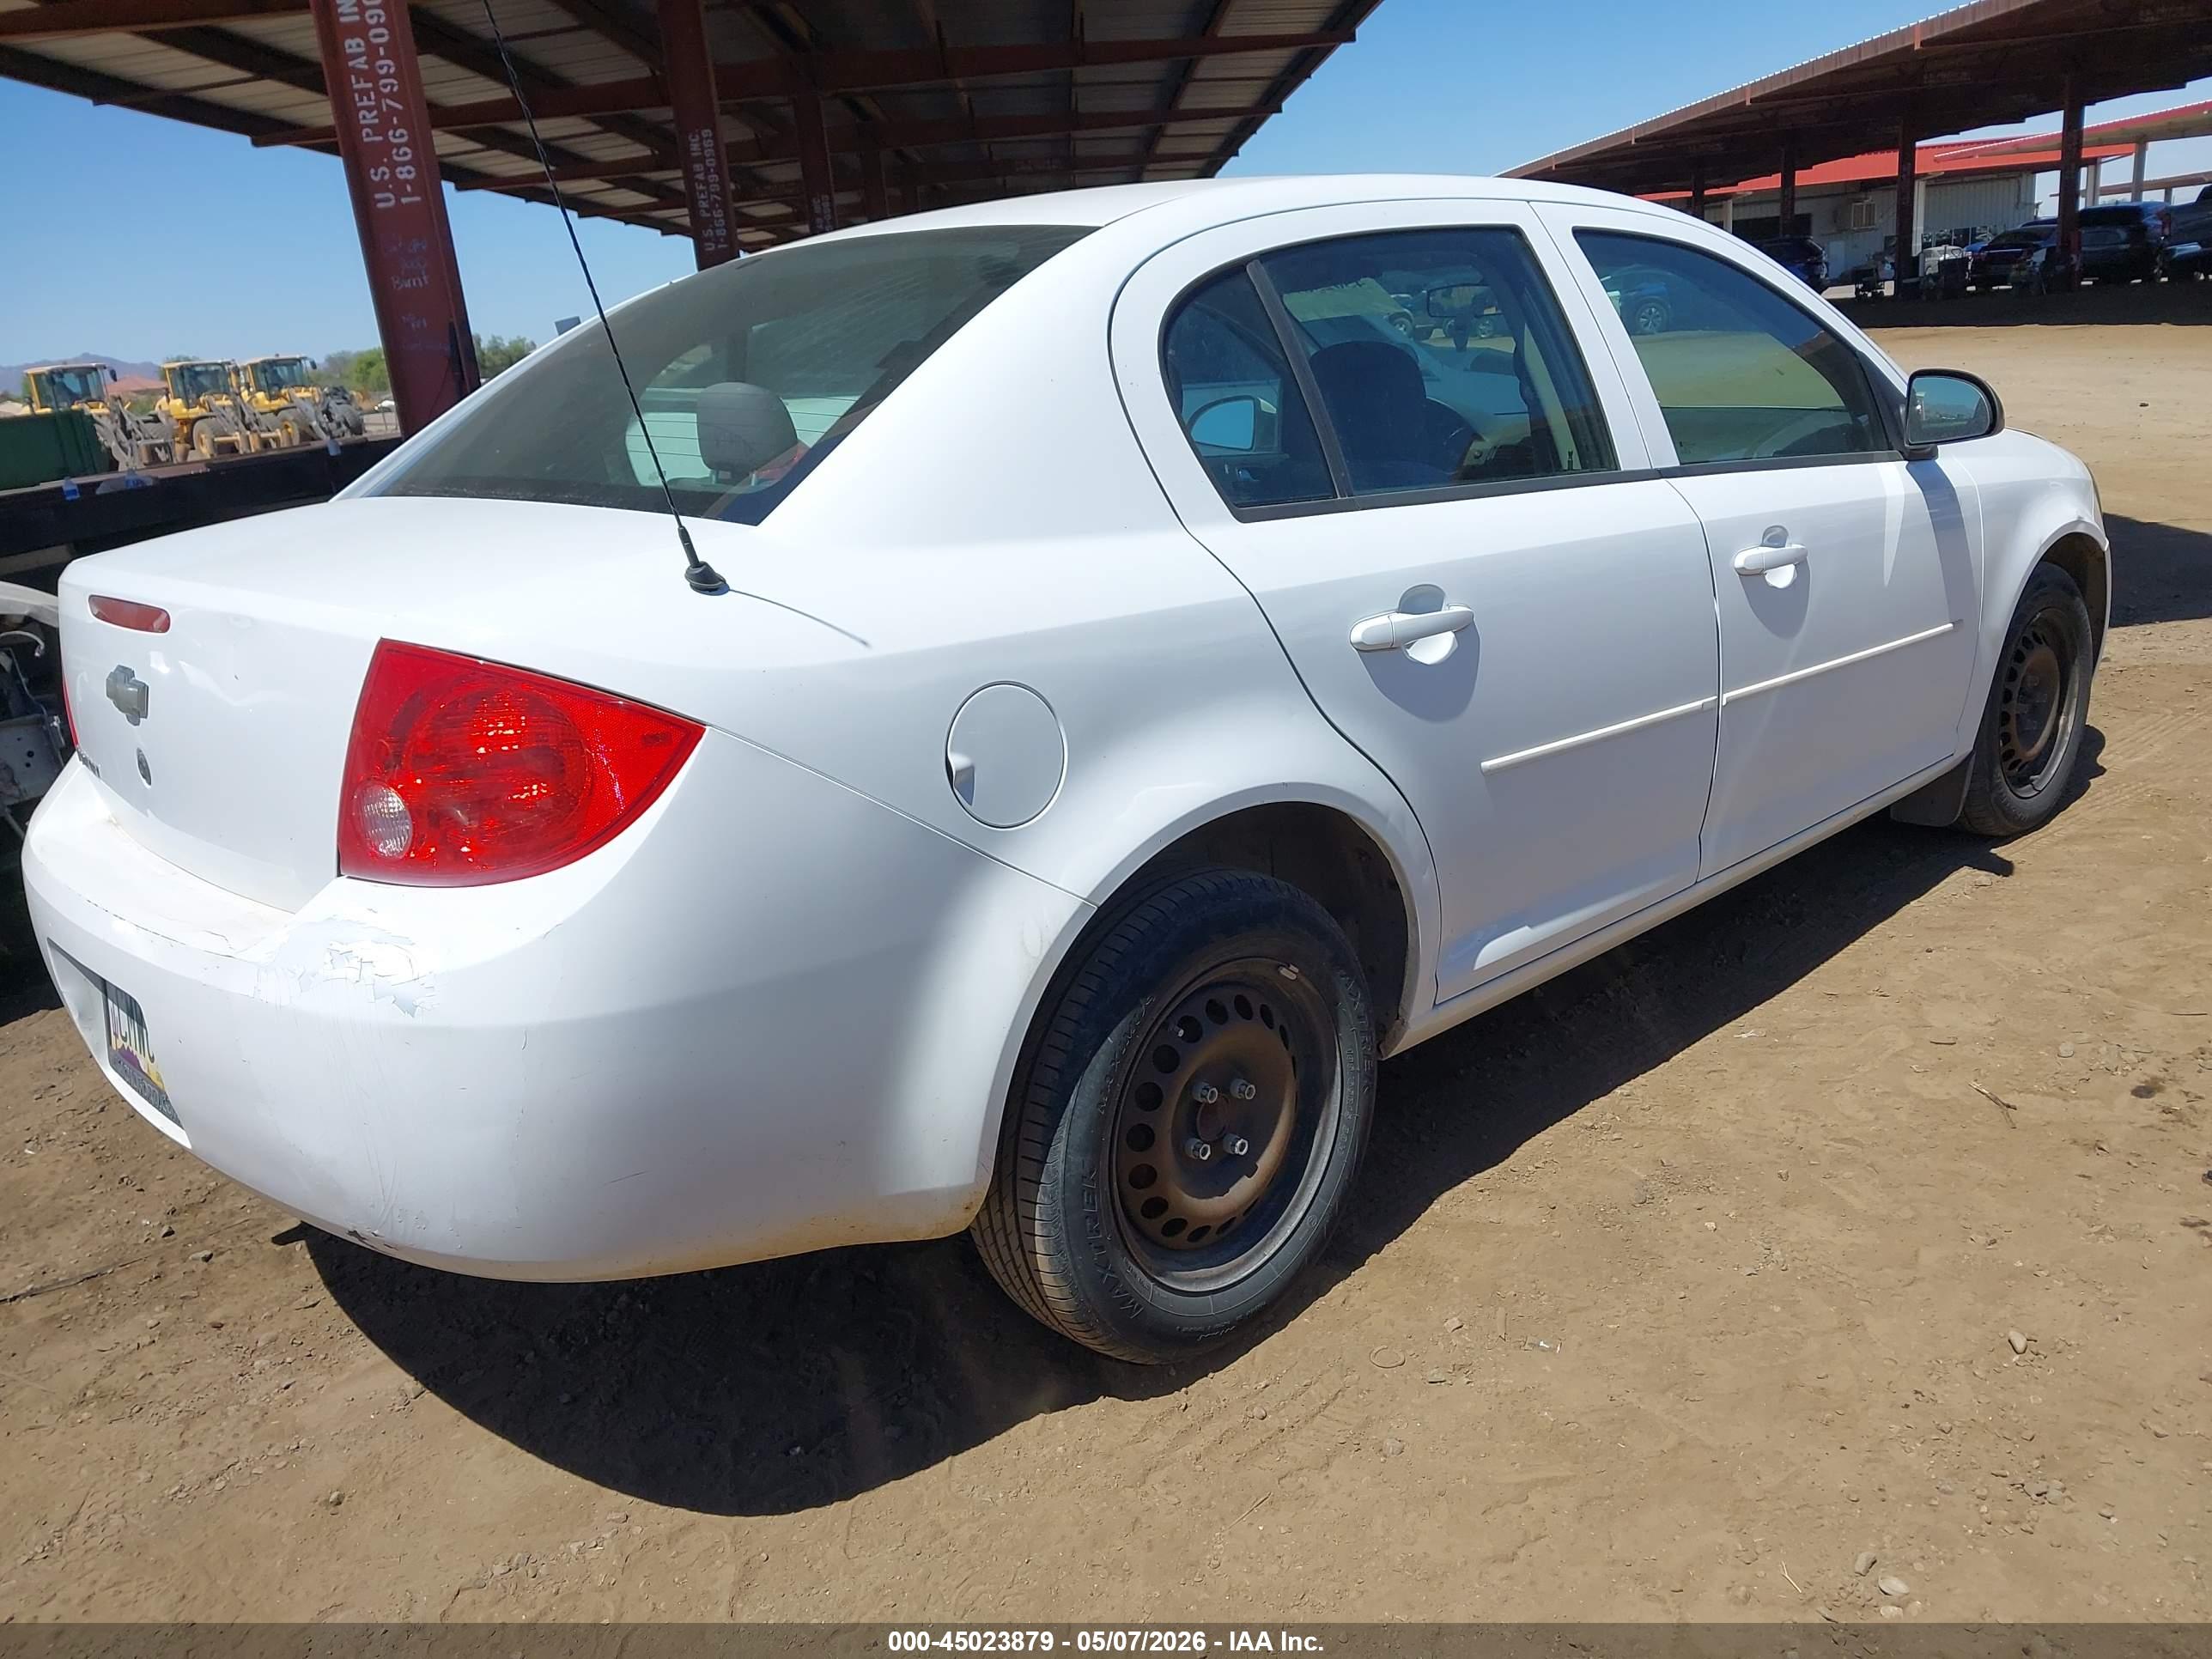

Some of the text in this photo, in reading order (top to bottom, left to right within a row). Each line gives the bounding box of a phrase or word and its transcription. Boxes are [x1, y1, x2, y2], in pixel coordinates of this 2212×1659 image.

[344, 37, 383, 143] PREFAB
[370, 156, 396, 209] U.S.
[692, 161, 711, 218] PREFAB
[1081, 1167, 1146, 1320] MAXTREK
